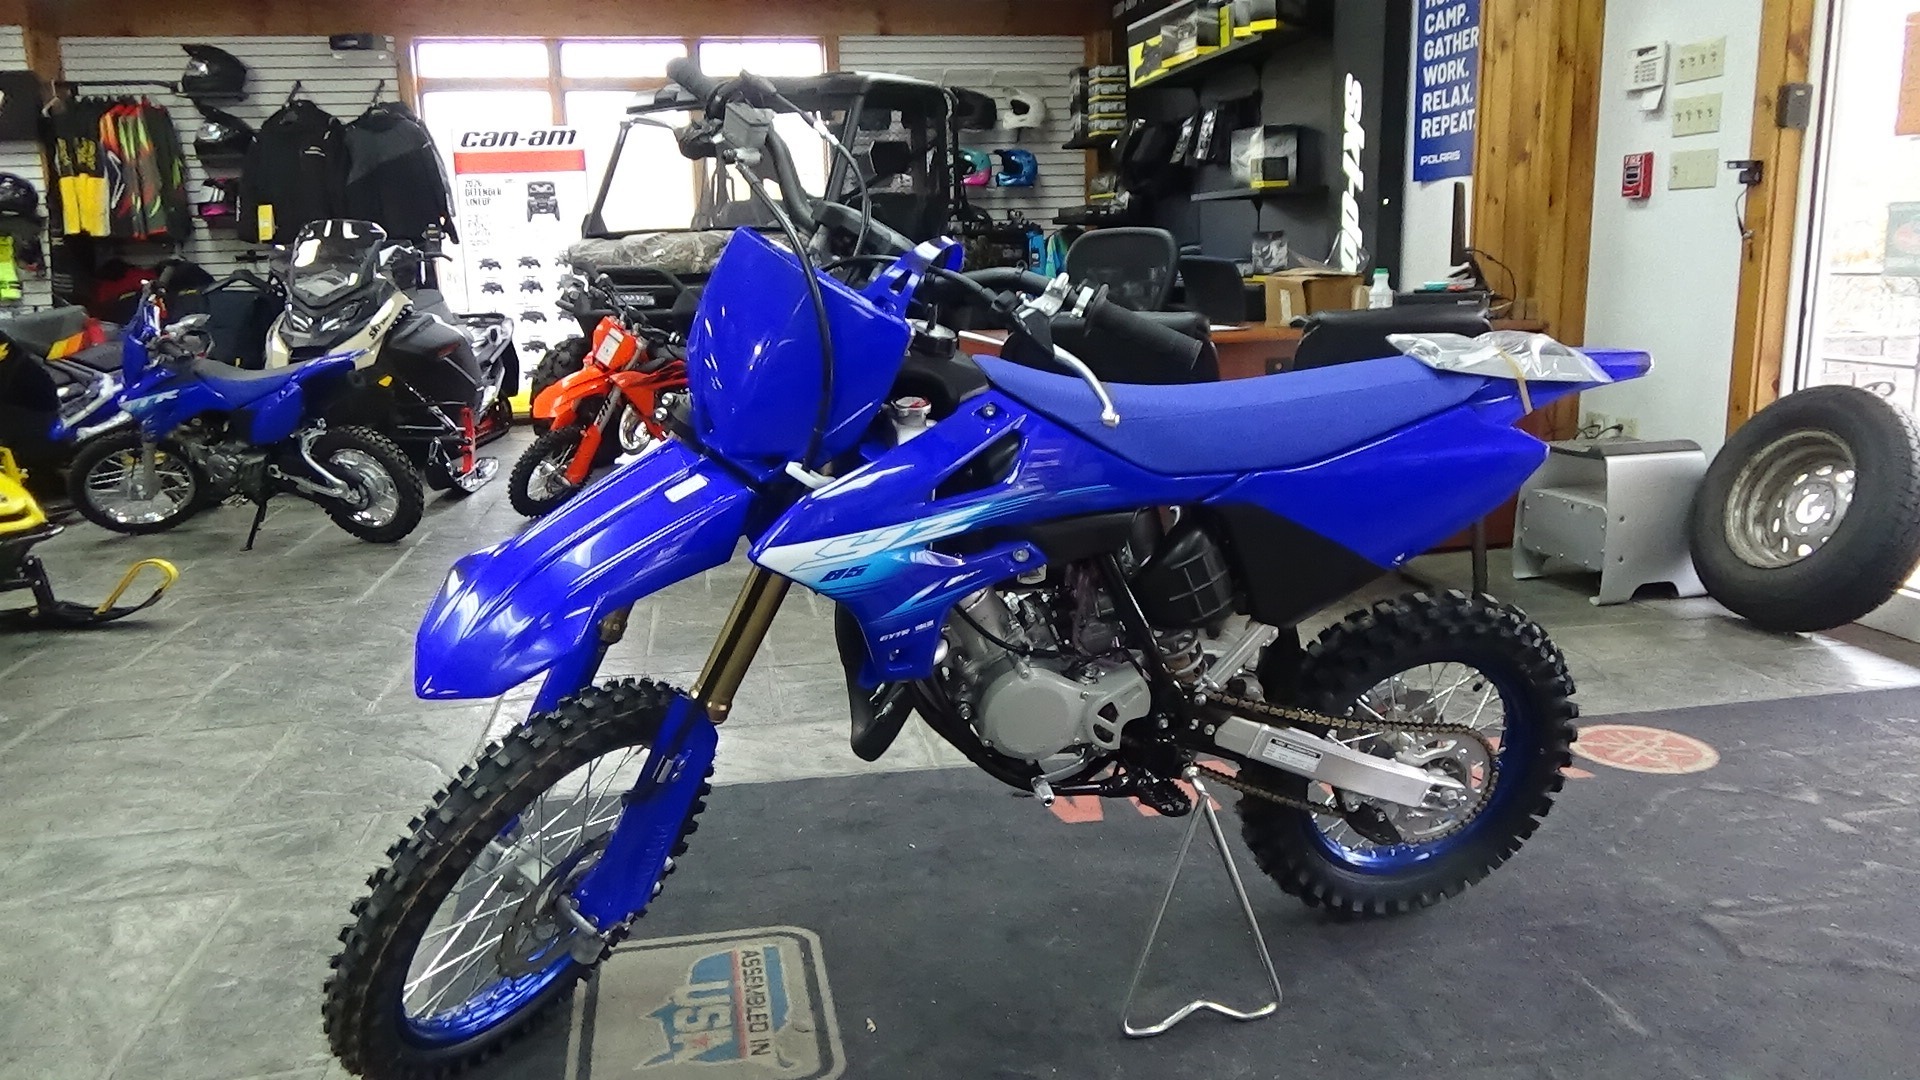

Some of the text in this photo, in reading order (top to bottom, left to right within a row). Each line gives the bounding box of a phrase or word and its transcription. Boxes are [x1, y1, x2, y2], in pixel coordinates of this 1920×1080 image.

[1424, 2, 1470, 35] CAMP.
[1422, 57, 1470, 87] WORK.
[1422, 81, 1474, 114] RELAX.
[1420, 150, 1461, 166] POLARIS
[1625, 155, 1642, 166] FIRE
[819, 564, 872, 583] 85
[741, 950, 771, 1056] ASSEMBLED IN
[672, 980, 732, 1065] USA
